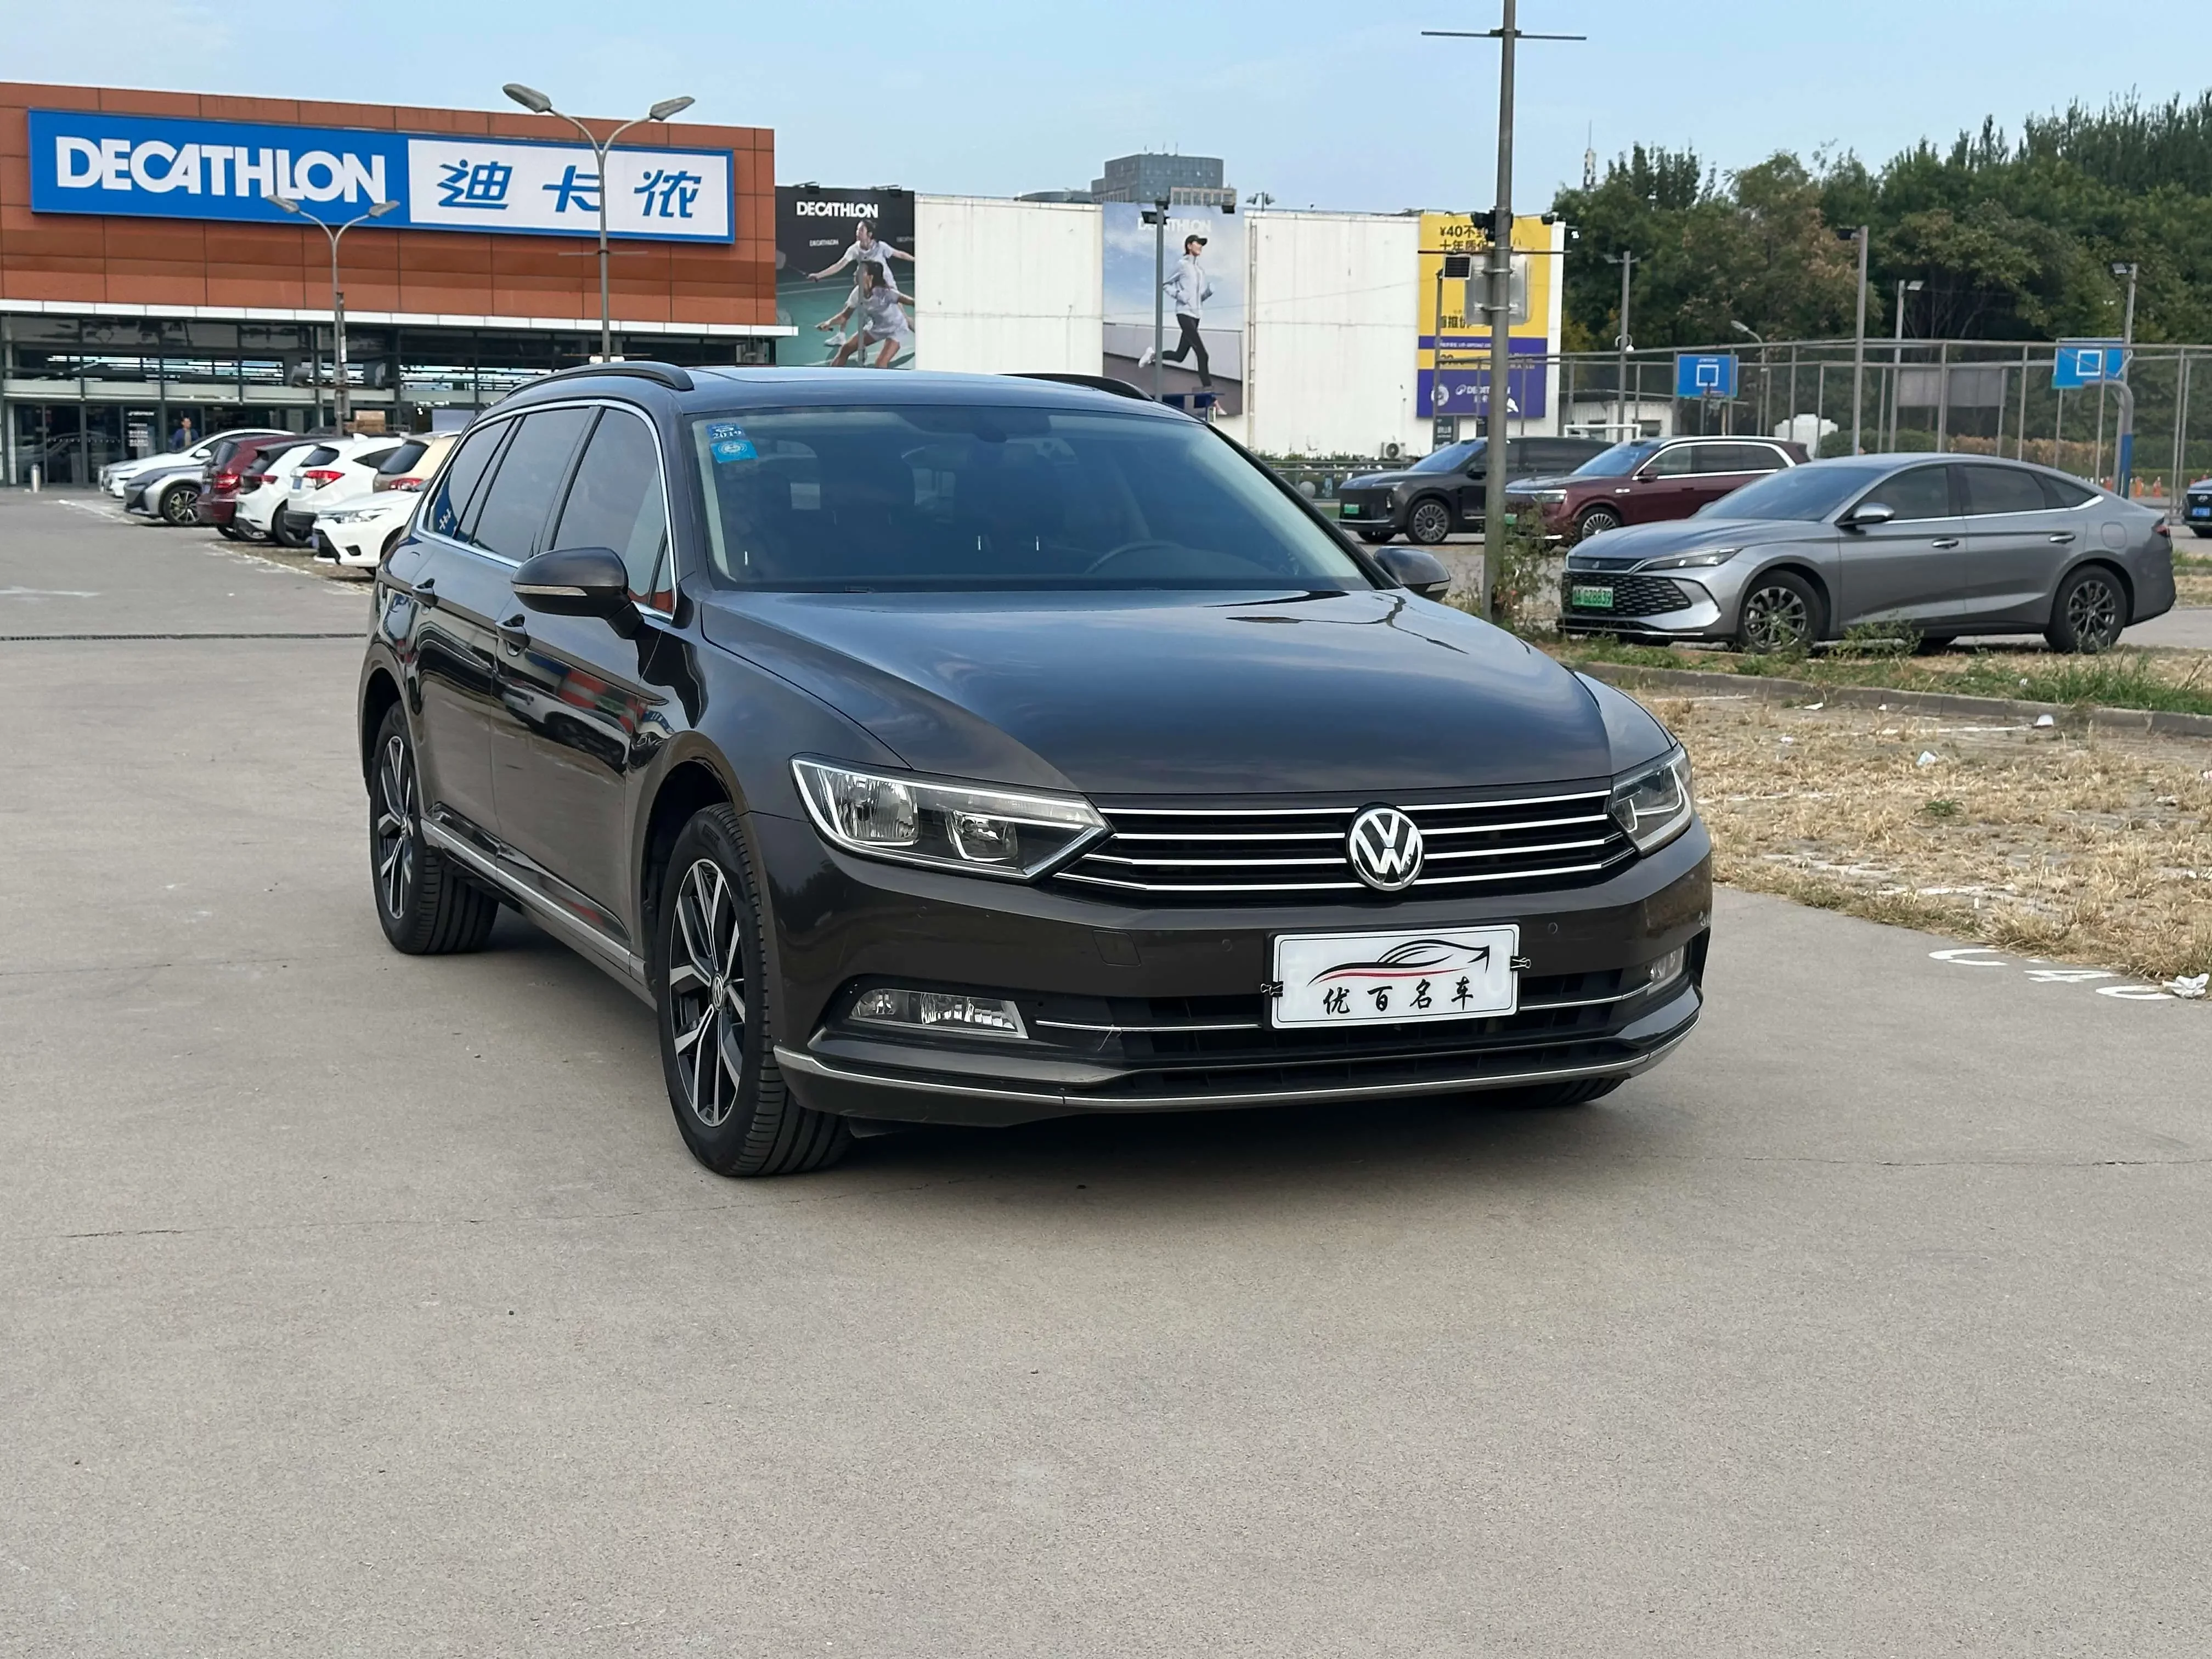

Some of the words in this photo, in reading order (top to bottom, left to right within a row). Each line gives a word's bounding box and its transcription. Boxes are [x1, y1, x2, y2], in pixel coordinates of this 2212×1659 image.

[55, 136, 386, 206] DECATHLON
[437, 159, 702, 219] 迪卡侬
[796, 201, 879, 218] DECATHLON
[1137, 218, 1212, 233] DATHLON
[1323, 976, 1474, 1015] 优百名车
